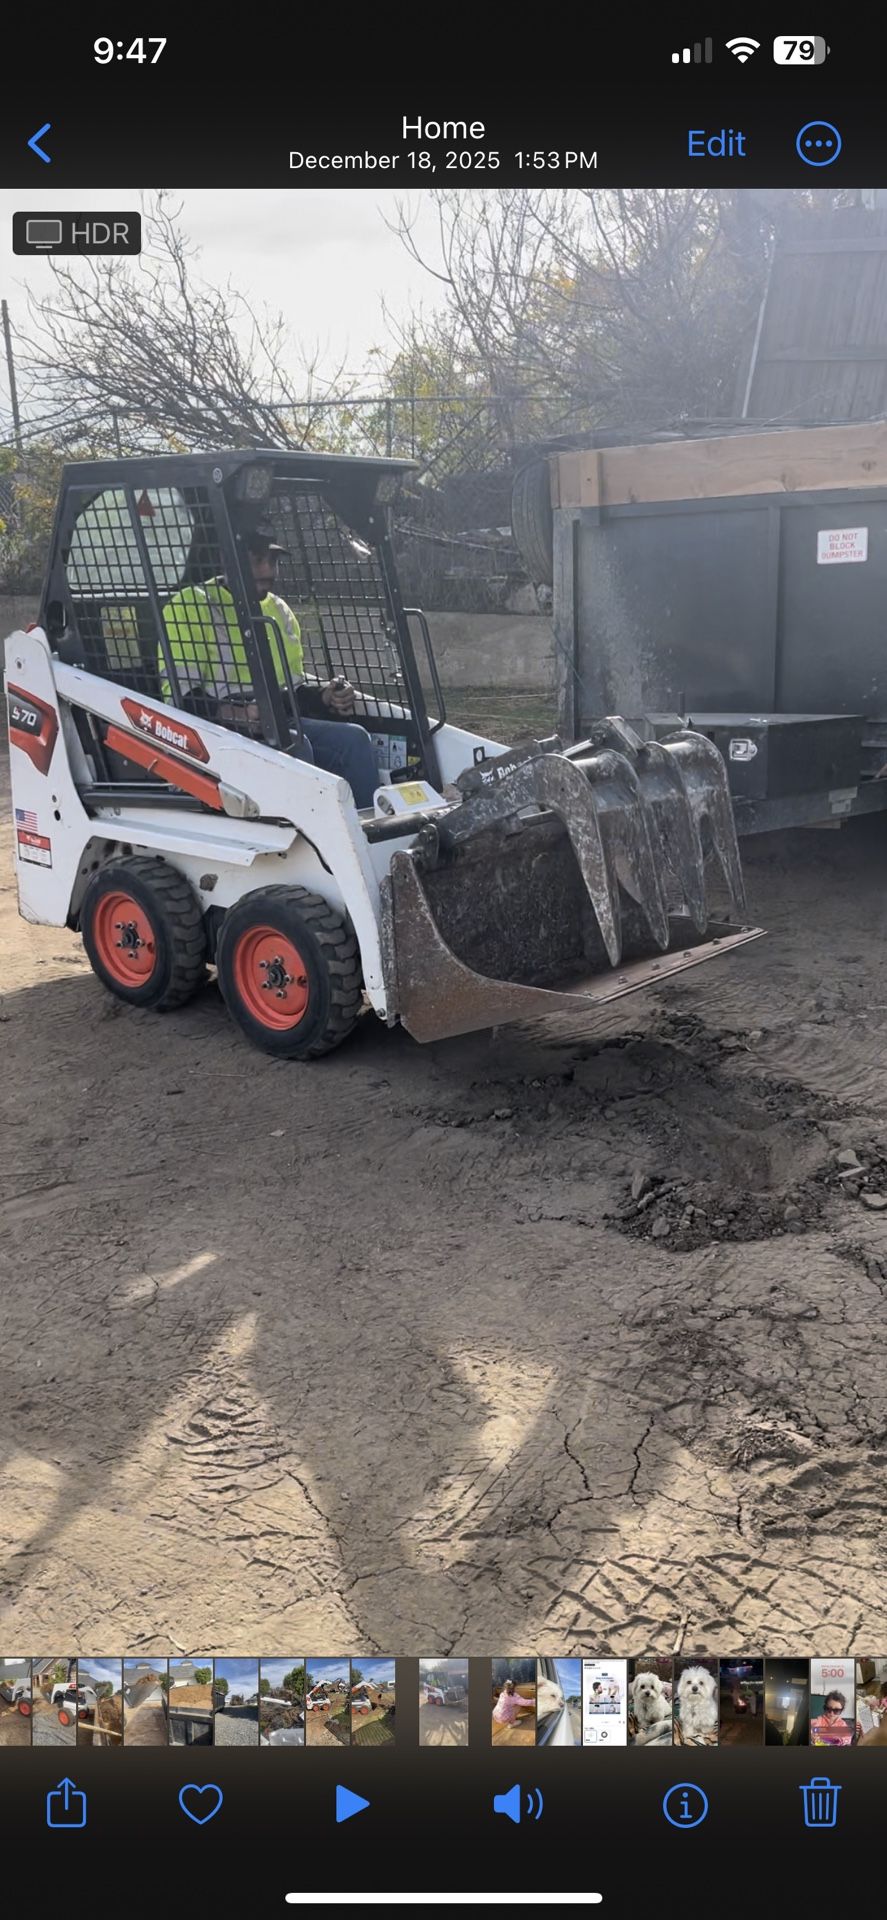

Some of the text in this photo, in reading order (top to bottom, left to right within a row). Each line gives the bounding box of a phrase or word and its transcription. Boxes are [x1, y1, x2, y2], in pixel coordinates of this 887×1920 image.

[829, 532, 858, 542] DO NOT
[829, 542, 856, 550] BLOCK
[821, 550, 864, 560] DUMPSTER
[11, 705, 38, 727] S70
[155, 720, 189, 750] Bobcat
[821, 1668, 845, 1678] 5:00
